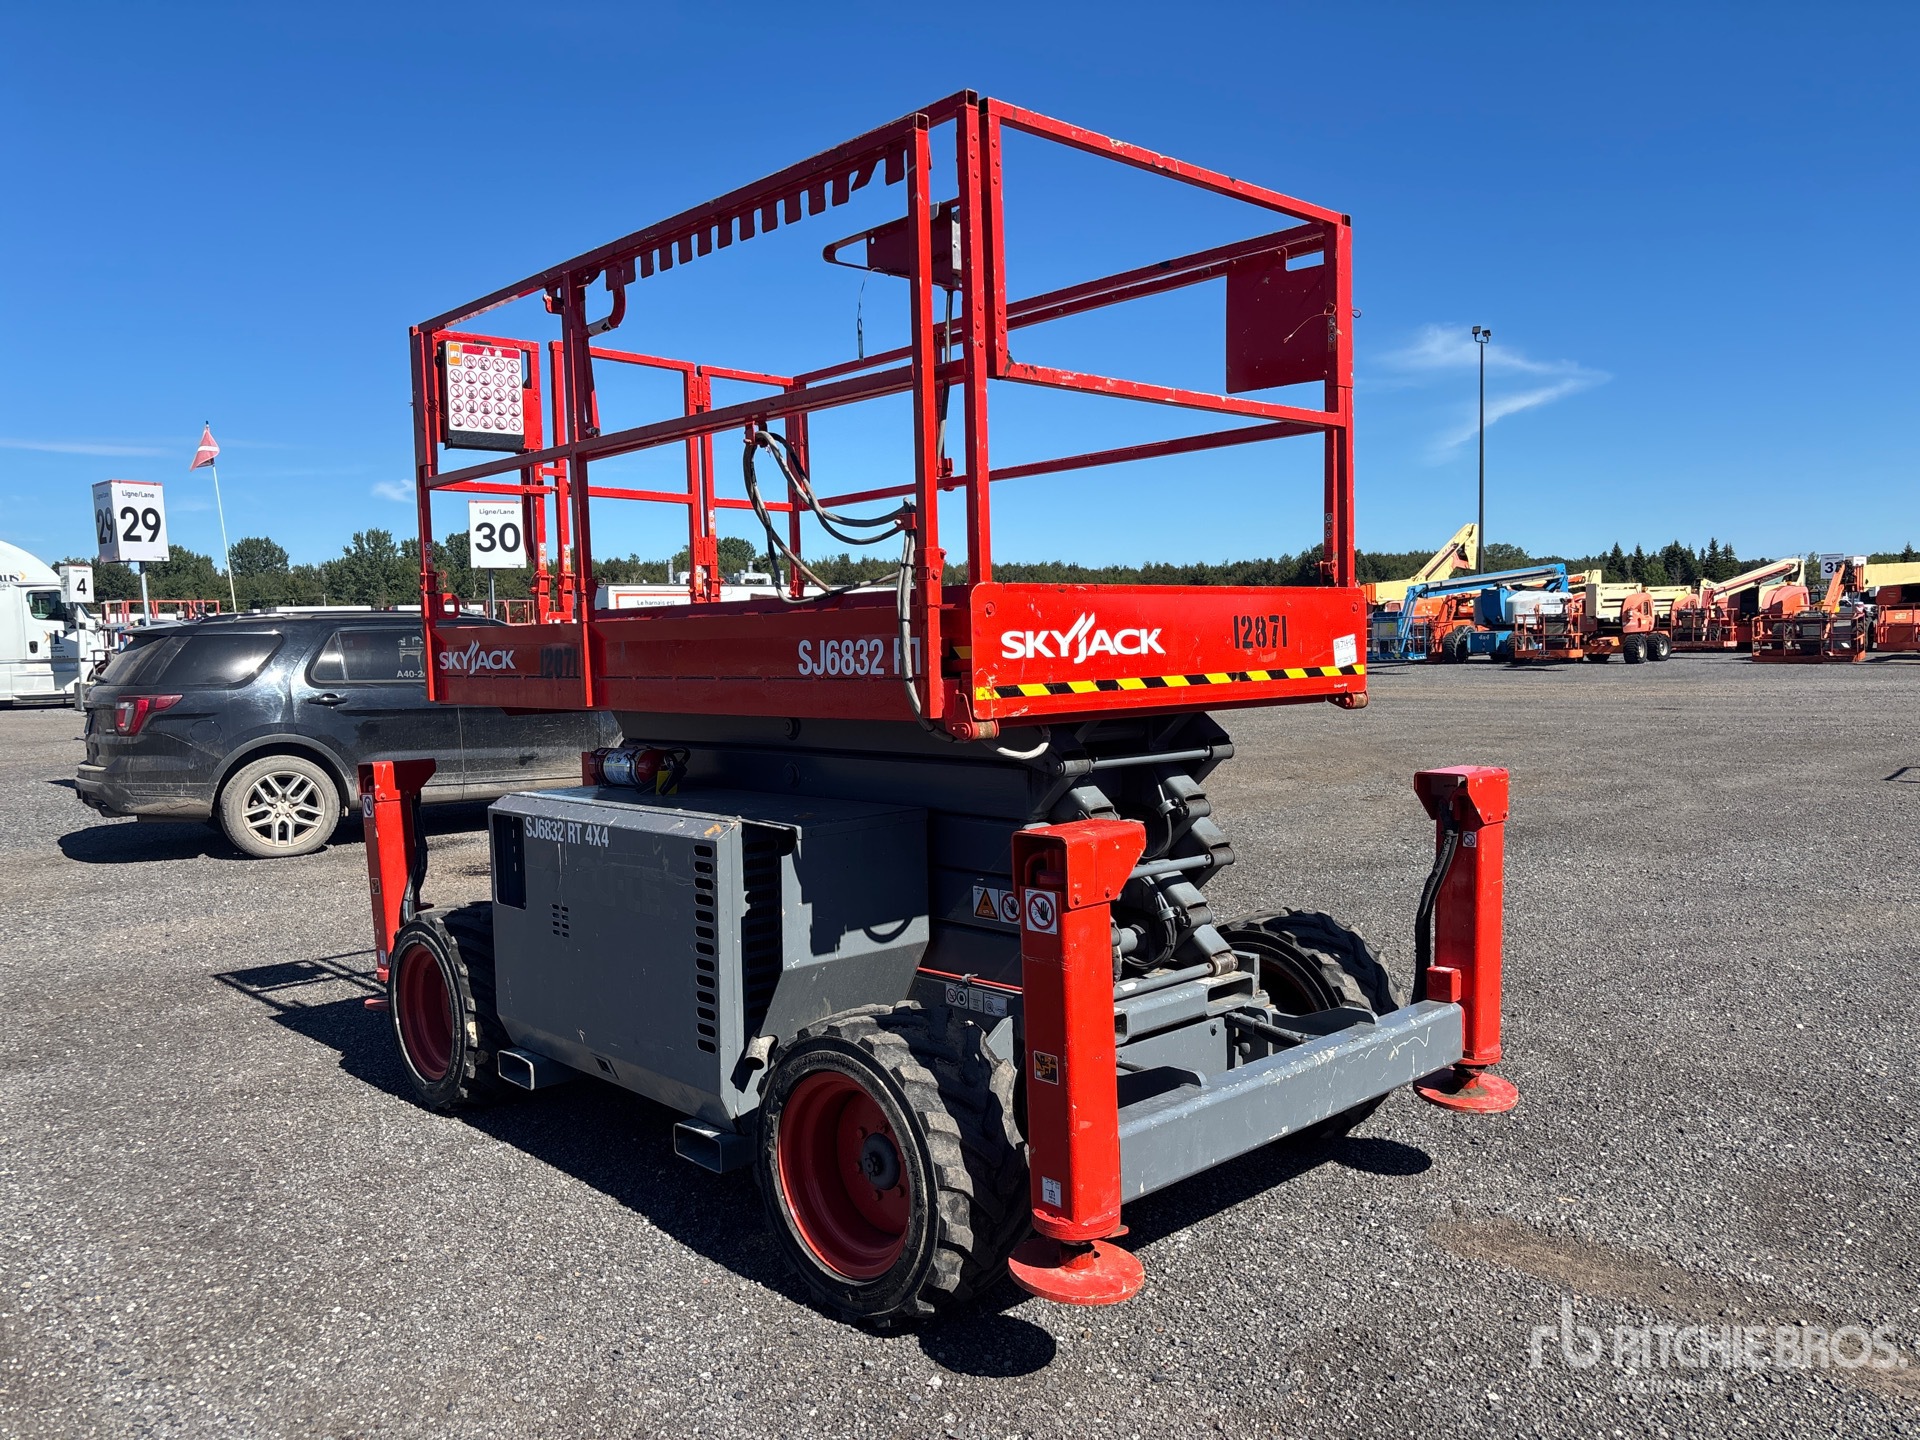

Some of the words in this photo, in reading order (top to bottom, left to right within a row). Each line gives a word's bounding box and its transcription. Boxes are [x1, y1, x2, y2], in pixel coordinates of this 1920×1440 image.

[121, 490, 155, 498] Ligne/Lane
[97, 507, 113, 545] 29
[120, 506, 162, 542] 29
[475, 522, 521, 553] 30
[76, 578, 87, 595] 4
[1000, 612, 1166, 664] SKYJACK
[1233, 614, 1288, 649] 12871
[439, 639, 516, 674] SKYJACK
[798, 638, 885, 675] SJ6832
[525, 816, 565, 842] SJ6832
[567, 822, 583, 845] RT
[585, 824, 610, 848] 4X4
